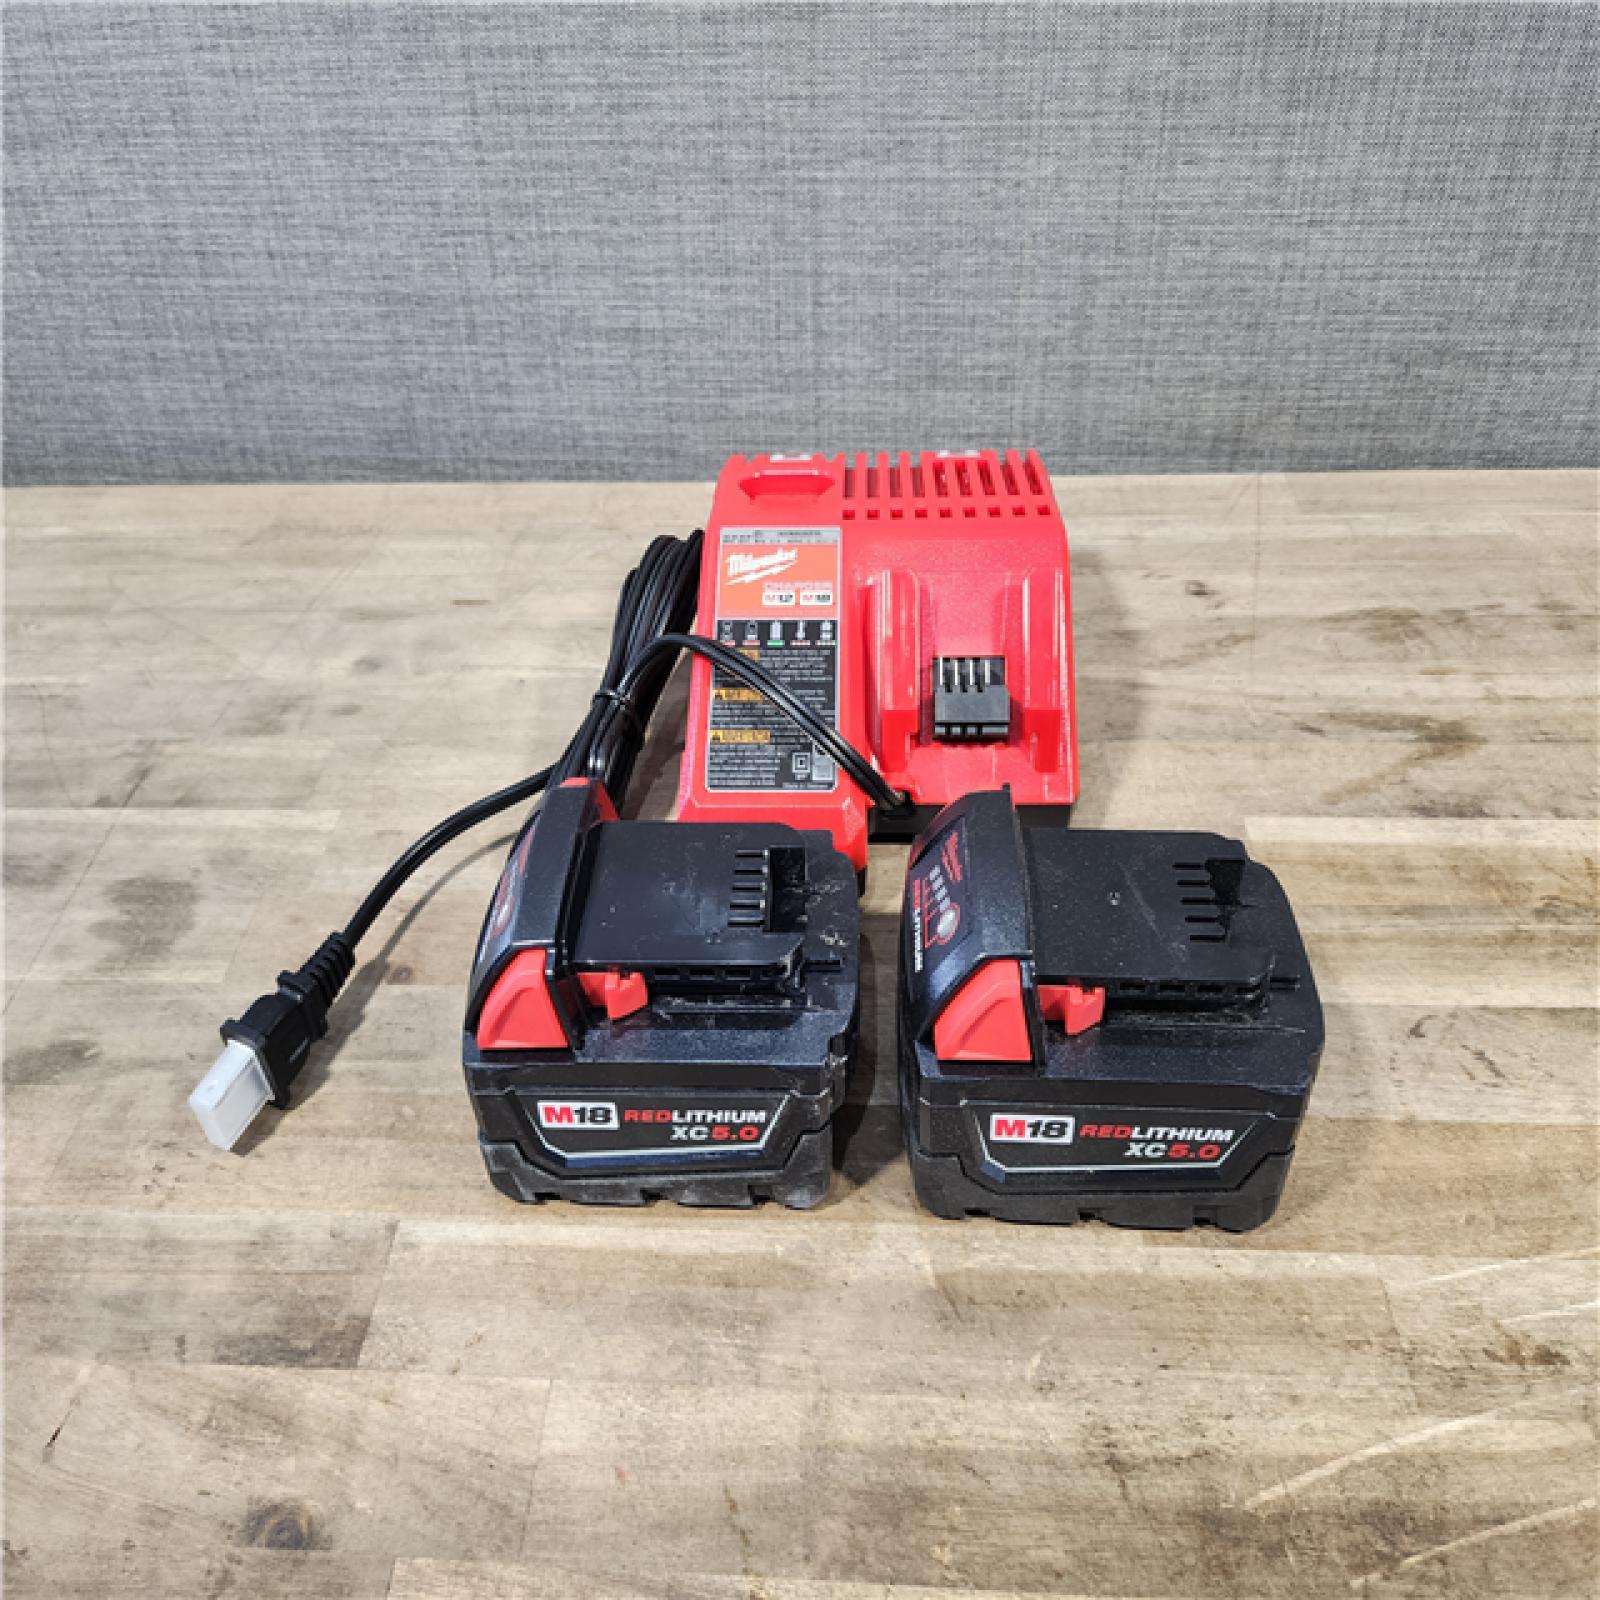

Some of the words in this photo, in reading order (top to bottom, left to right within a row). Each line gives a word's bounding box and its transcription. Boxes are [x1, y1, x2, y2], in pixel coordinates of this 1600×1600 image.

[542, 1105, 614, 1124] M18
[624, 1109, 767, 1124] REDLITHIUM
[994, 1118, 1069, 1138] M18
[1079, 1124, 1235, 1142] REDLITHIUM
